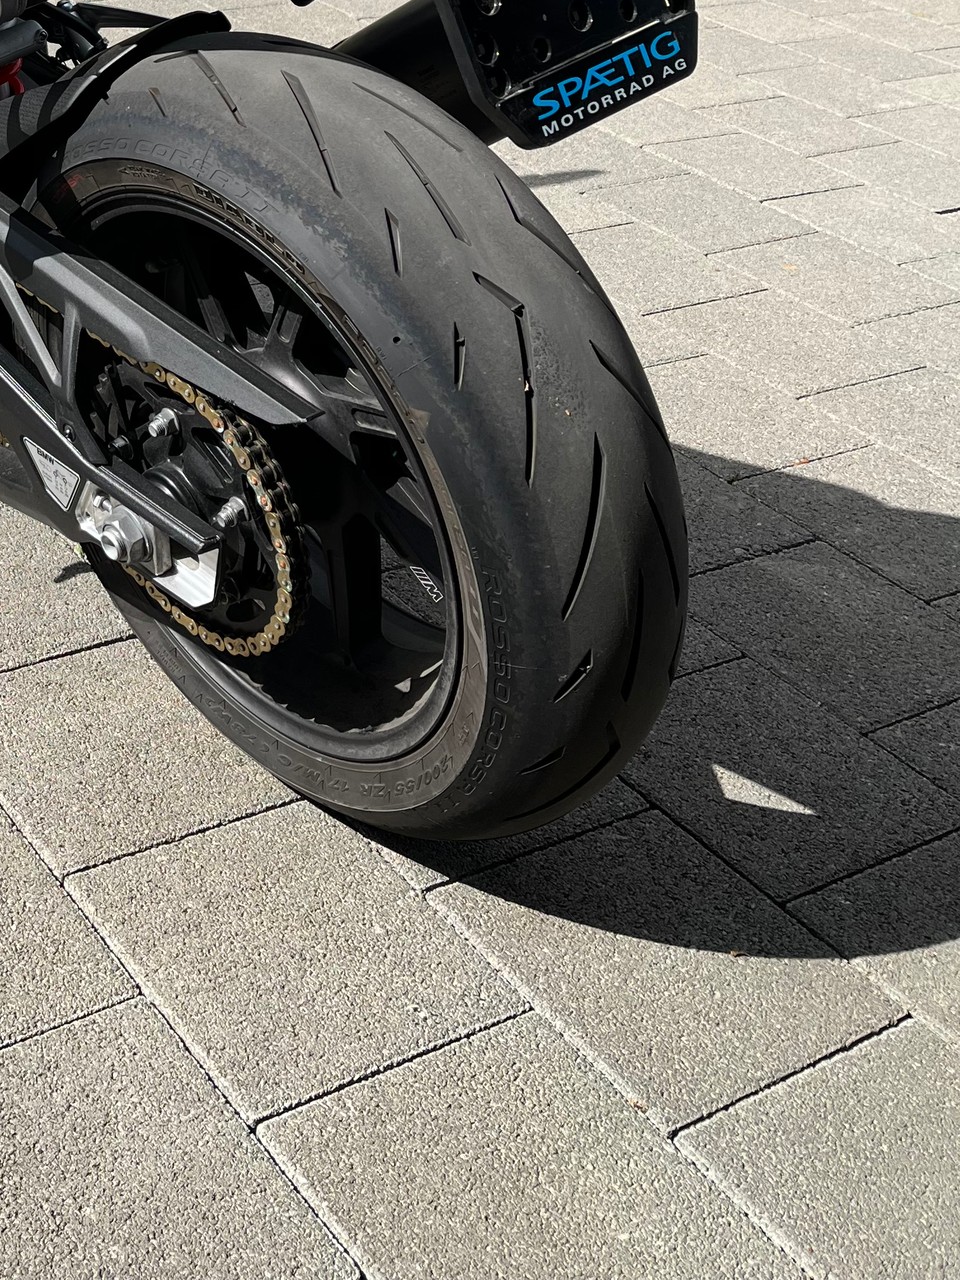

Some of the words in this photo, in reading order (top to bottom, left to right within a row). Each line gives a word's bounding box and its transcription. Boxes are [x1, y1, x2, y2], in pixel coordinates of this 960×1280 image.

[532, 31, 681, 120] SPÆTIG
[541, 74, 655, 137] MOTORRAD
[662, 58, 688, 79] AG
[37, 448, 55, 465] BMW
[480, 567, 511, 704] ROSSO
[328, 778, 350, 793] 17
[360, 783, 386, 798] ZR
[461, 710, 507, 797] CORSA
